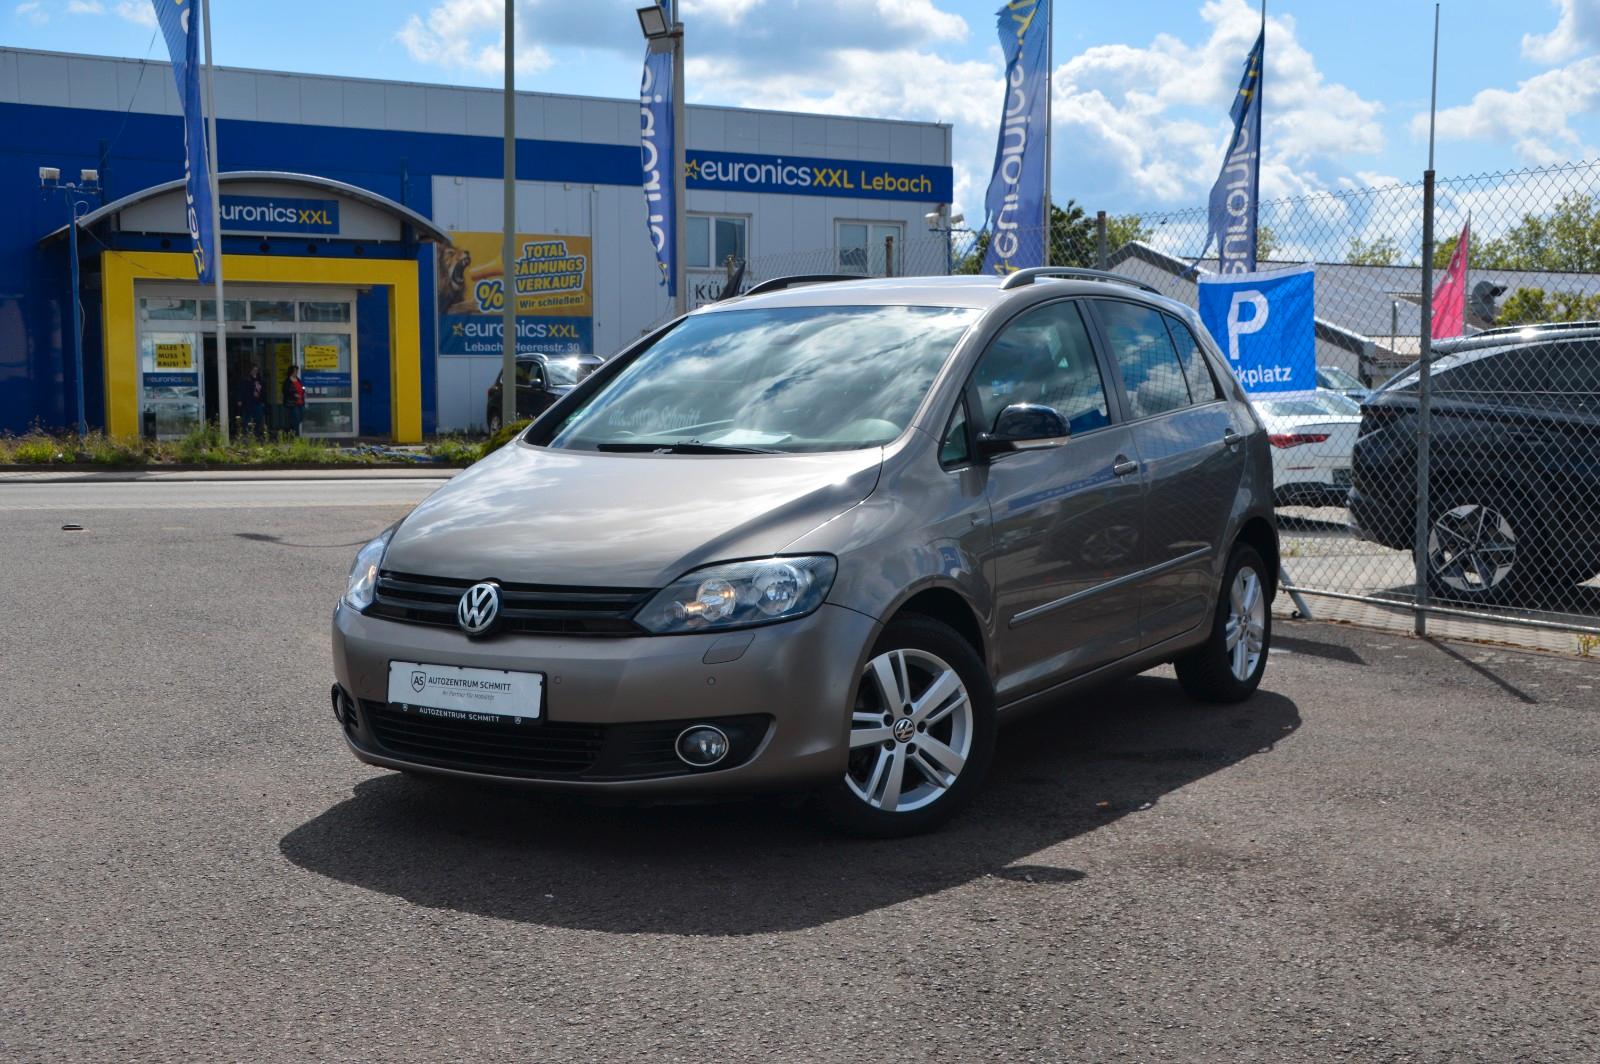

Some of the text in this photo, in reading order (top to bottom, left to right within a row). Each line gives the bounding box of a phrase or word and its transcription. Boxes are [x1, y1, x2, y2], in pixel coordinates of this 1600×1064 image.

[861, 172, 933, 193] Lebach
[526, 243, 566, 259] TOTAL
[517, 275, 582, 292] VERKAUF!
[519, 296, 584, 309] Wir schließen!
[1227, 290, 1269, 360] P
[567, 343, 580, 352] 30
[414, 676, 512, 691] AS AUTOZENTRUM SCHMITT
[418, 707, 500, 723] AUTOZENTRUM SCHMITT
